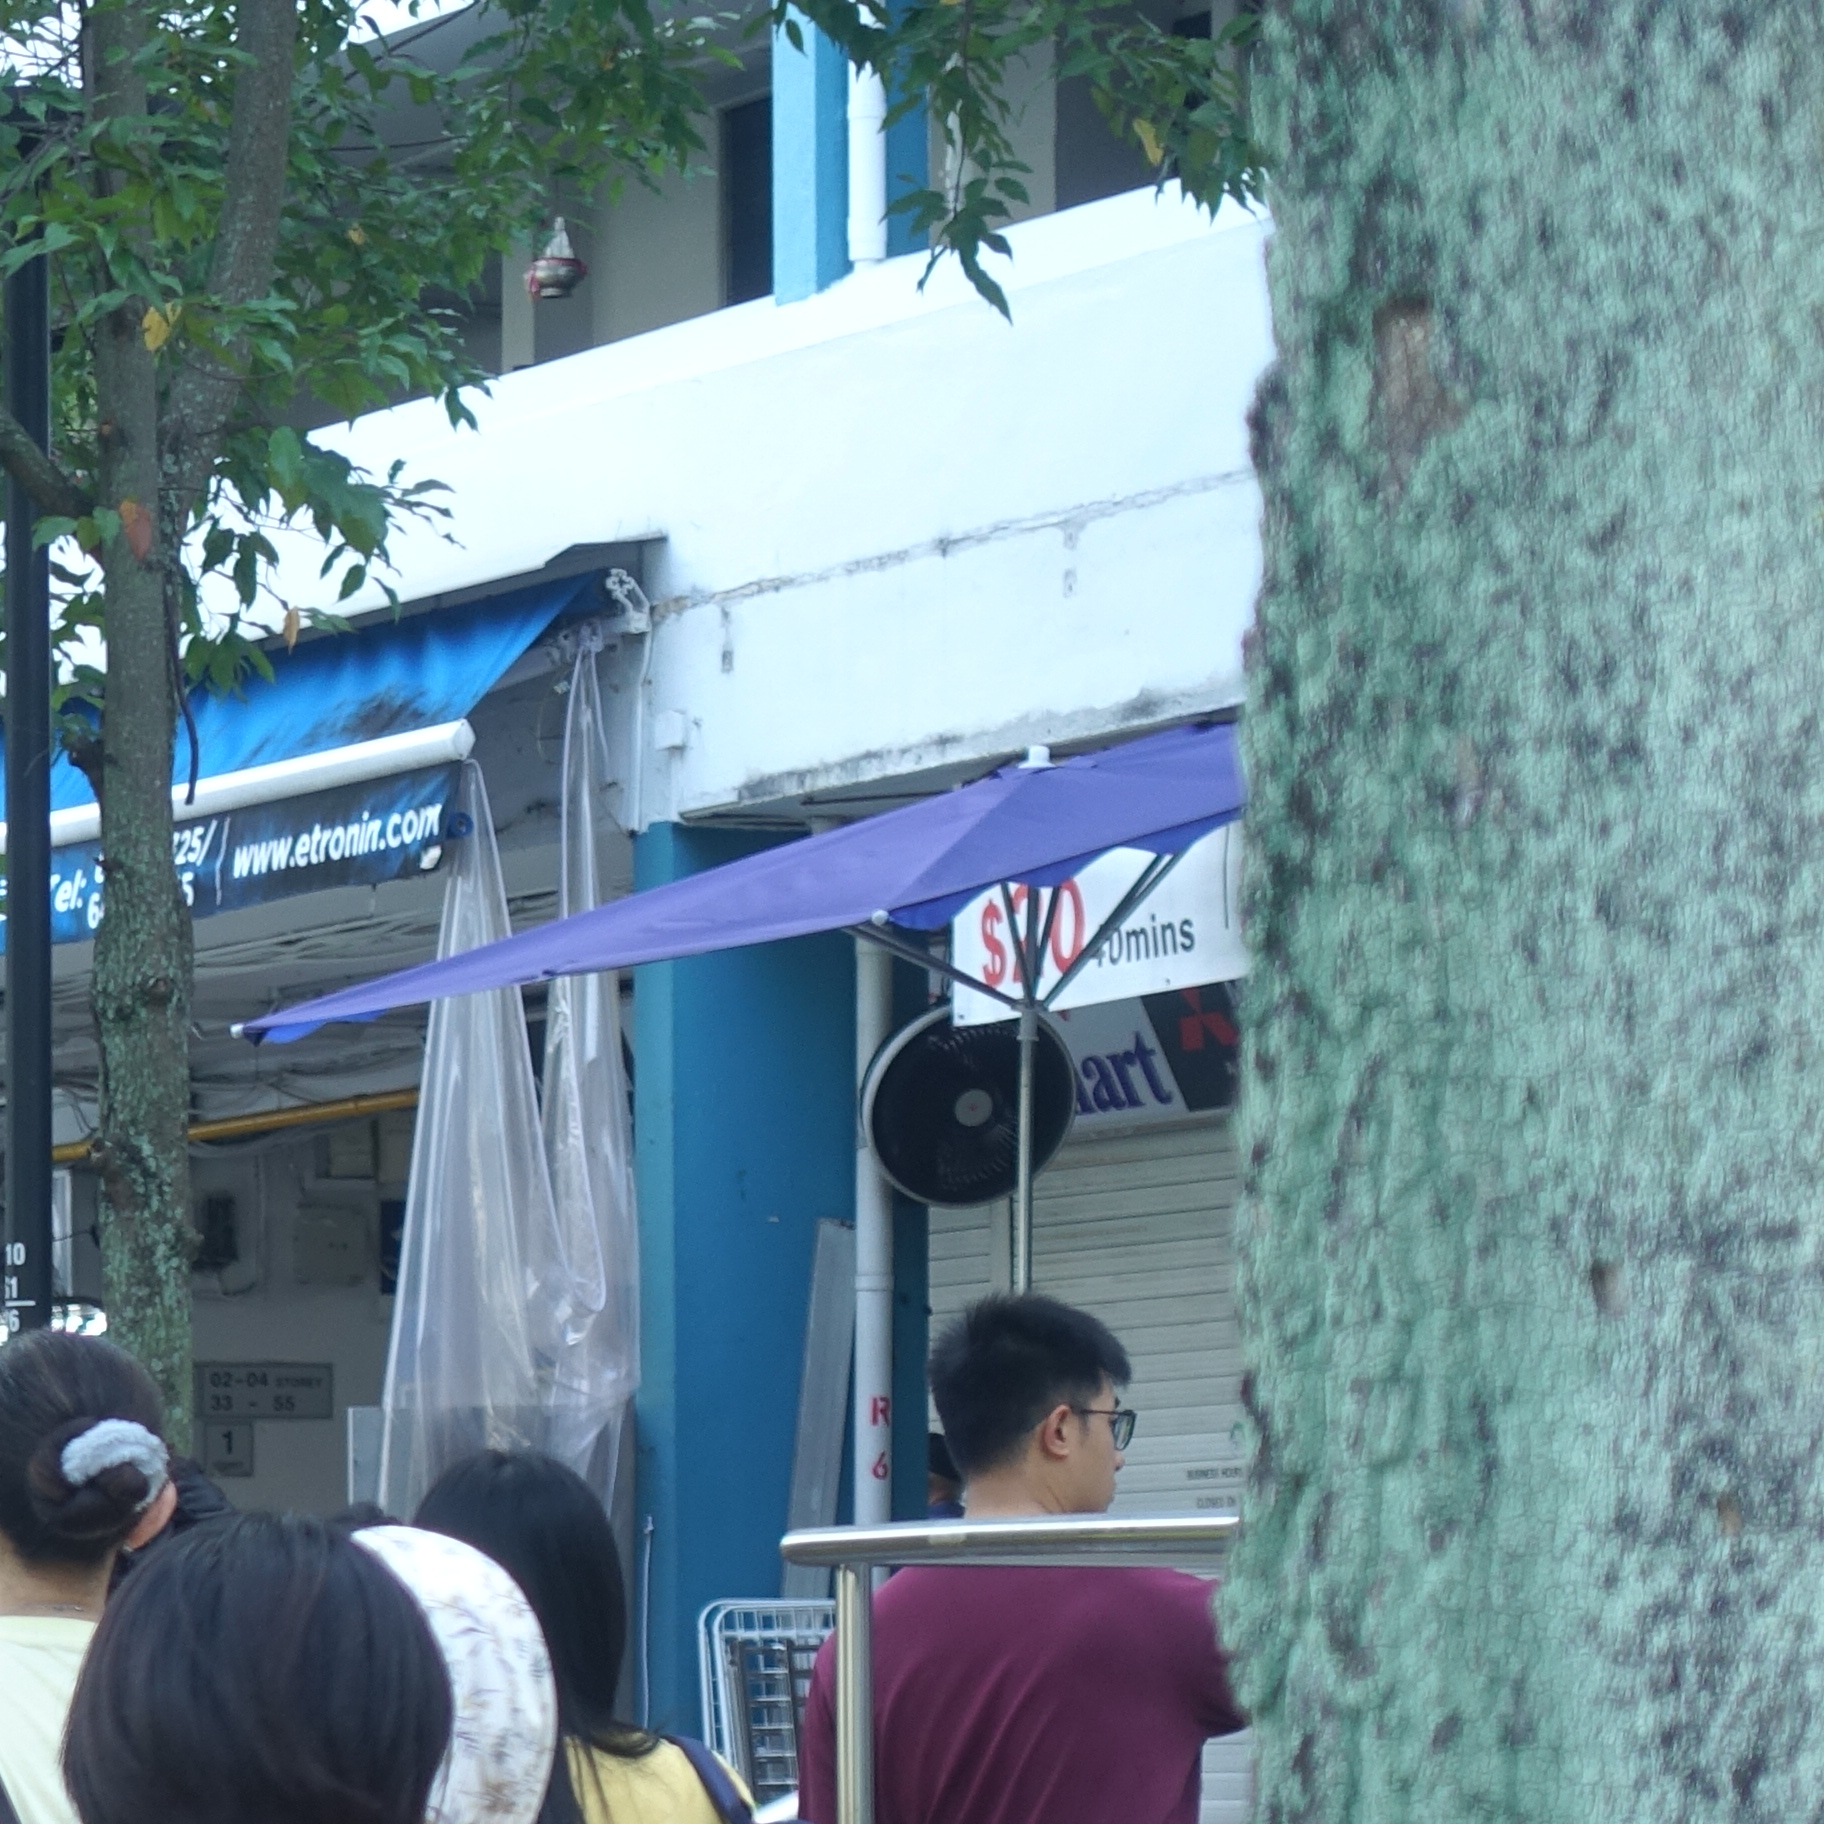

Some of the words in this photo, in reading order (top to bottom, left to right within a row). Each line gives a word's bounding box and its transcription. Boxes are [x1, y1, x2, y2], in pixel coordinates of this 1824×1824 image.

[232, 804, 442, 879] www.etronin.com
[1075, 1030, 1173, 1115] art
[5, 1242, 26, 1266] 10
[221, 1430, 233, 1455] 1
